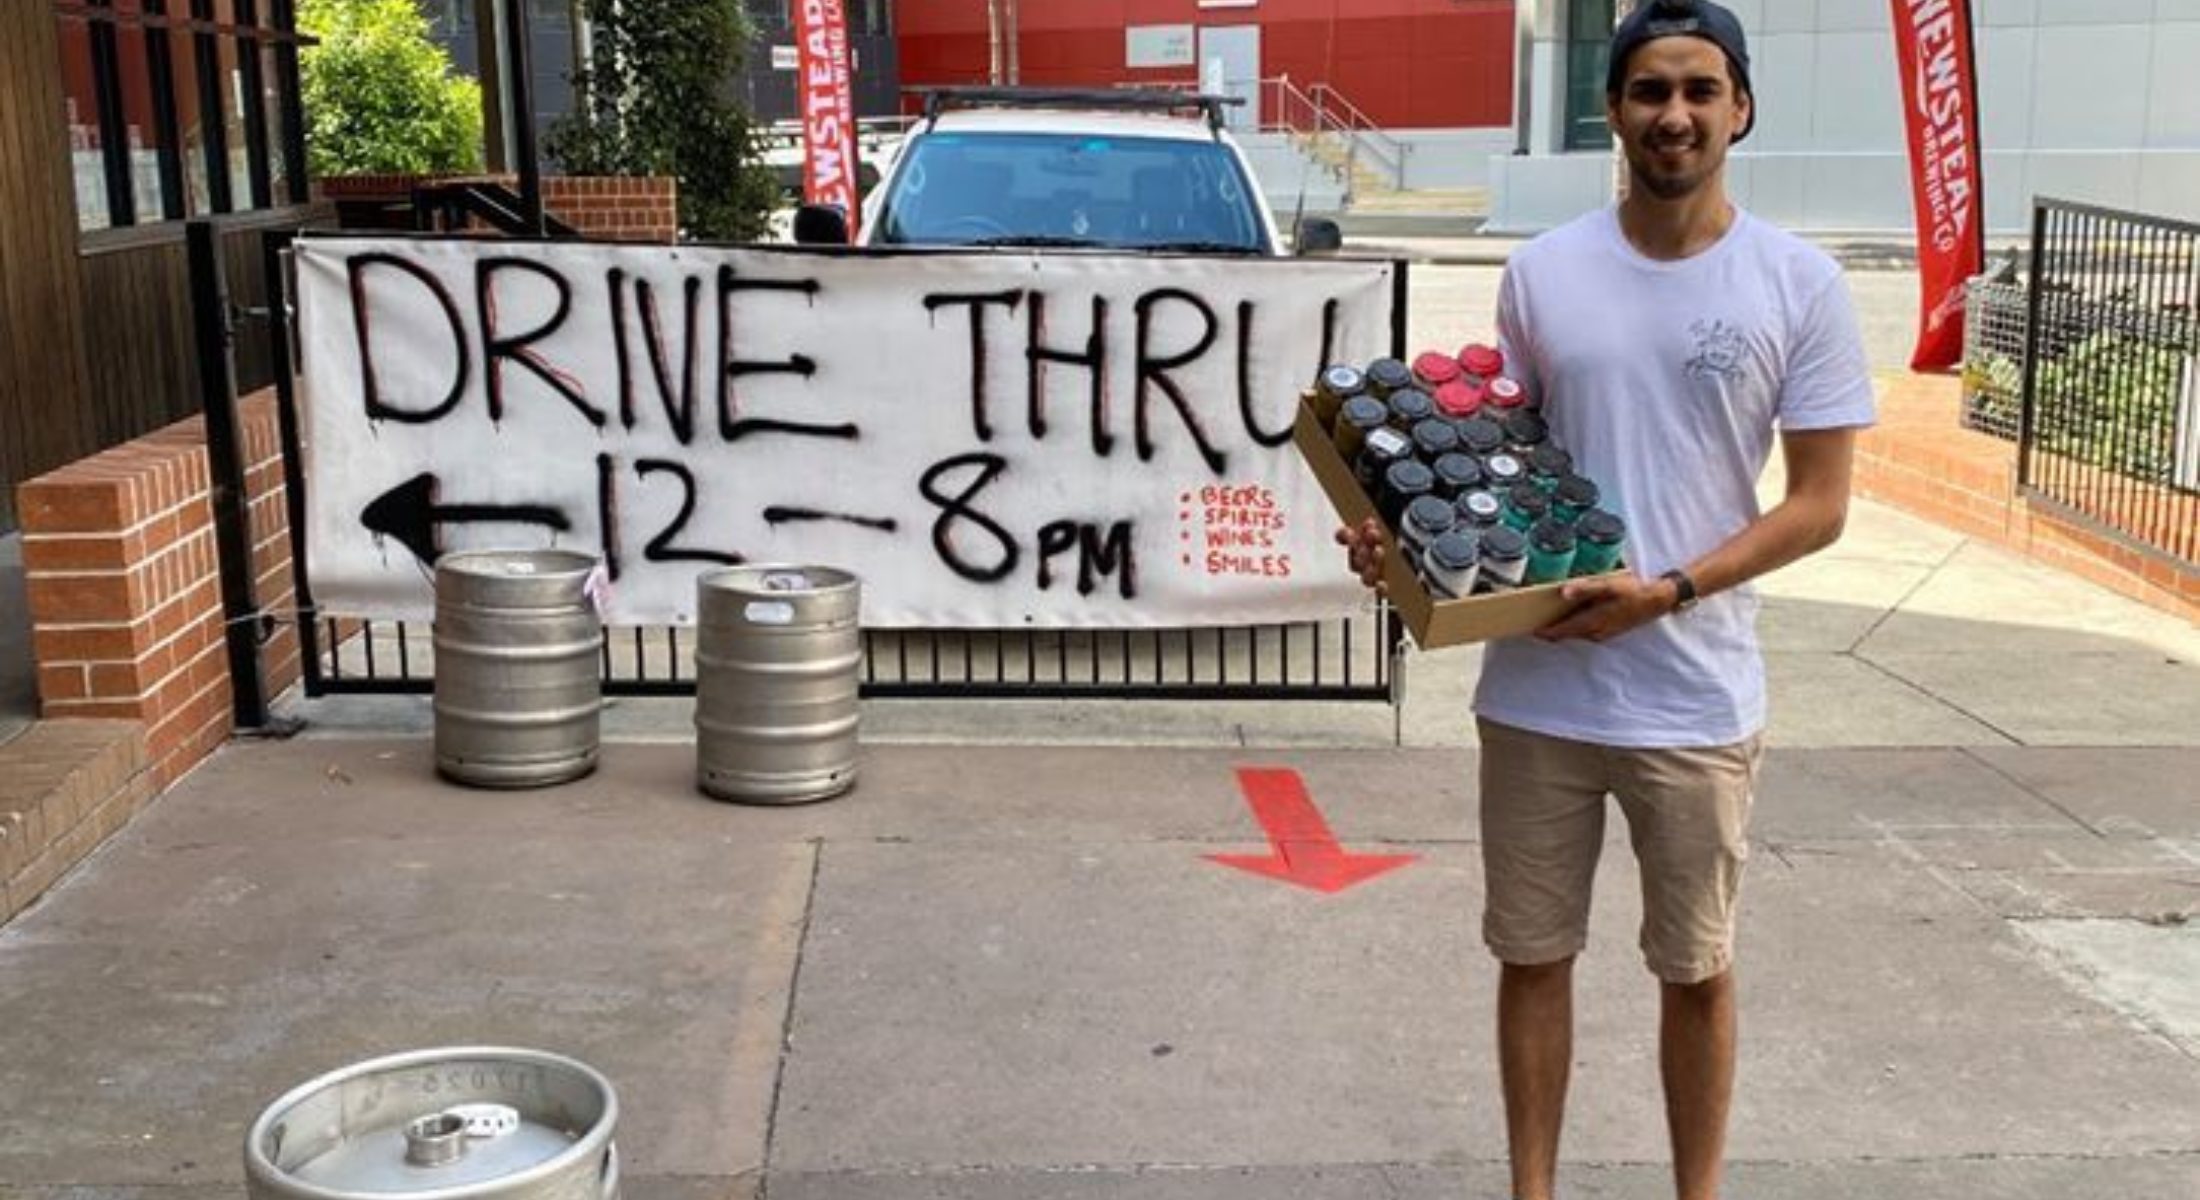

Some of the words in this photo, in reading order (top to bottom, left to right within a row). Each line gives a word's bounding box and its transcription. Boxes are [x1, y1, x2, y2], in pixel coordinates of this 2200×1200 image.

[804, 0, 849, 212] EWSTEAD
[346, 253, 859, 445] DRIVE
[923, 287, 1338, 476] THRU
[1199, 486, 1274, 509] BEERS
[596, 453, 746, 583] 12
[1204, 508, 1285, 530] SPIRITS
[1205, 529, 1274, 548] WINES
[1206, 550, 1291, 577] SMILES
